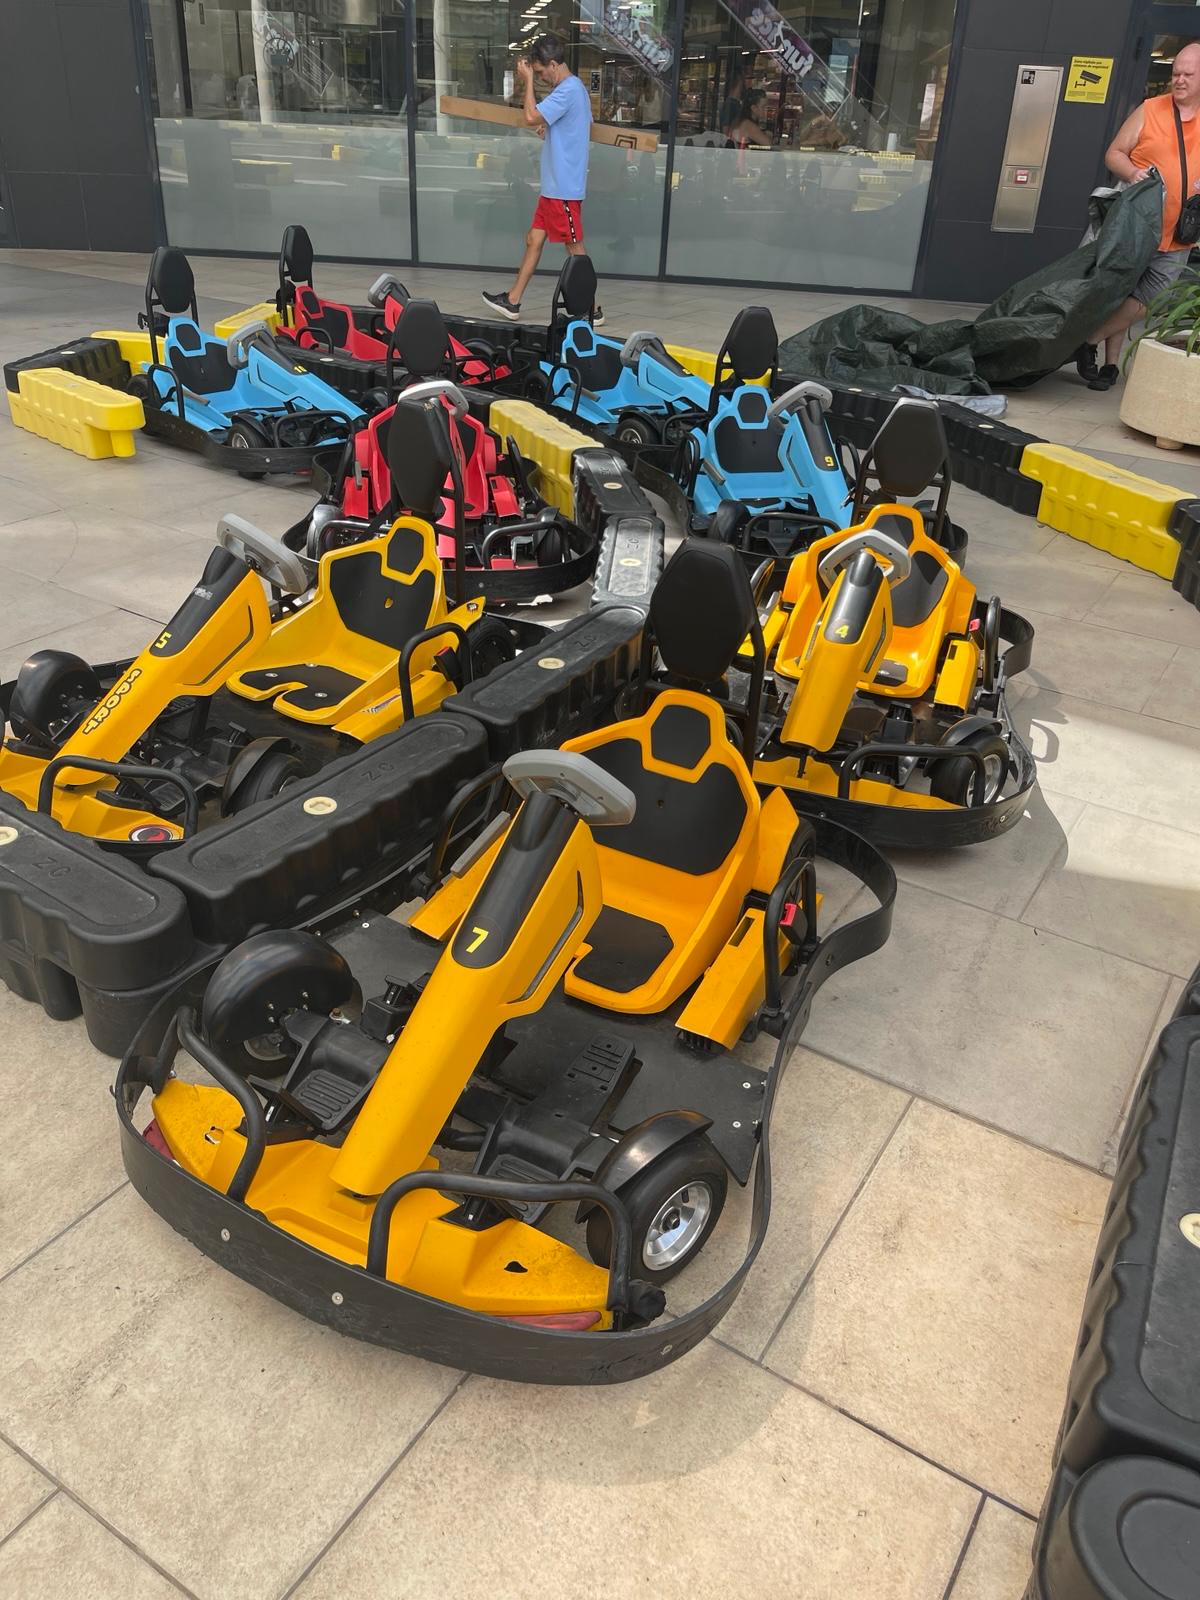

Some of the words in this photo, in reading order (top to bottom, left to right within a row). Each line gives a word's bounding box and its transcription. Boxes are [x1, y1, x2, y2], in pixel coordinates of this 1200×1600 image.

[824, 456, 834, 467] 9
[155, 631, 172, 649] 5
[834, 623, 849, 639] 4
[83, 668, 142, 735] SPORT
[465, 926, 489, 953] 7
